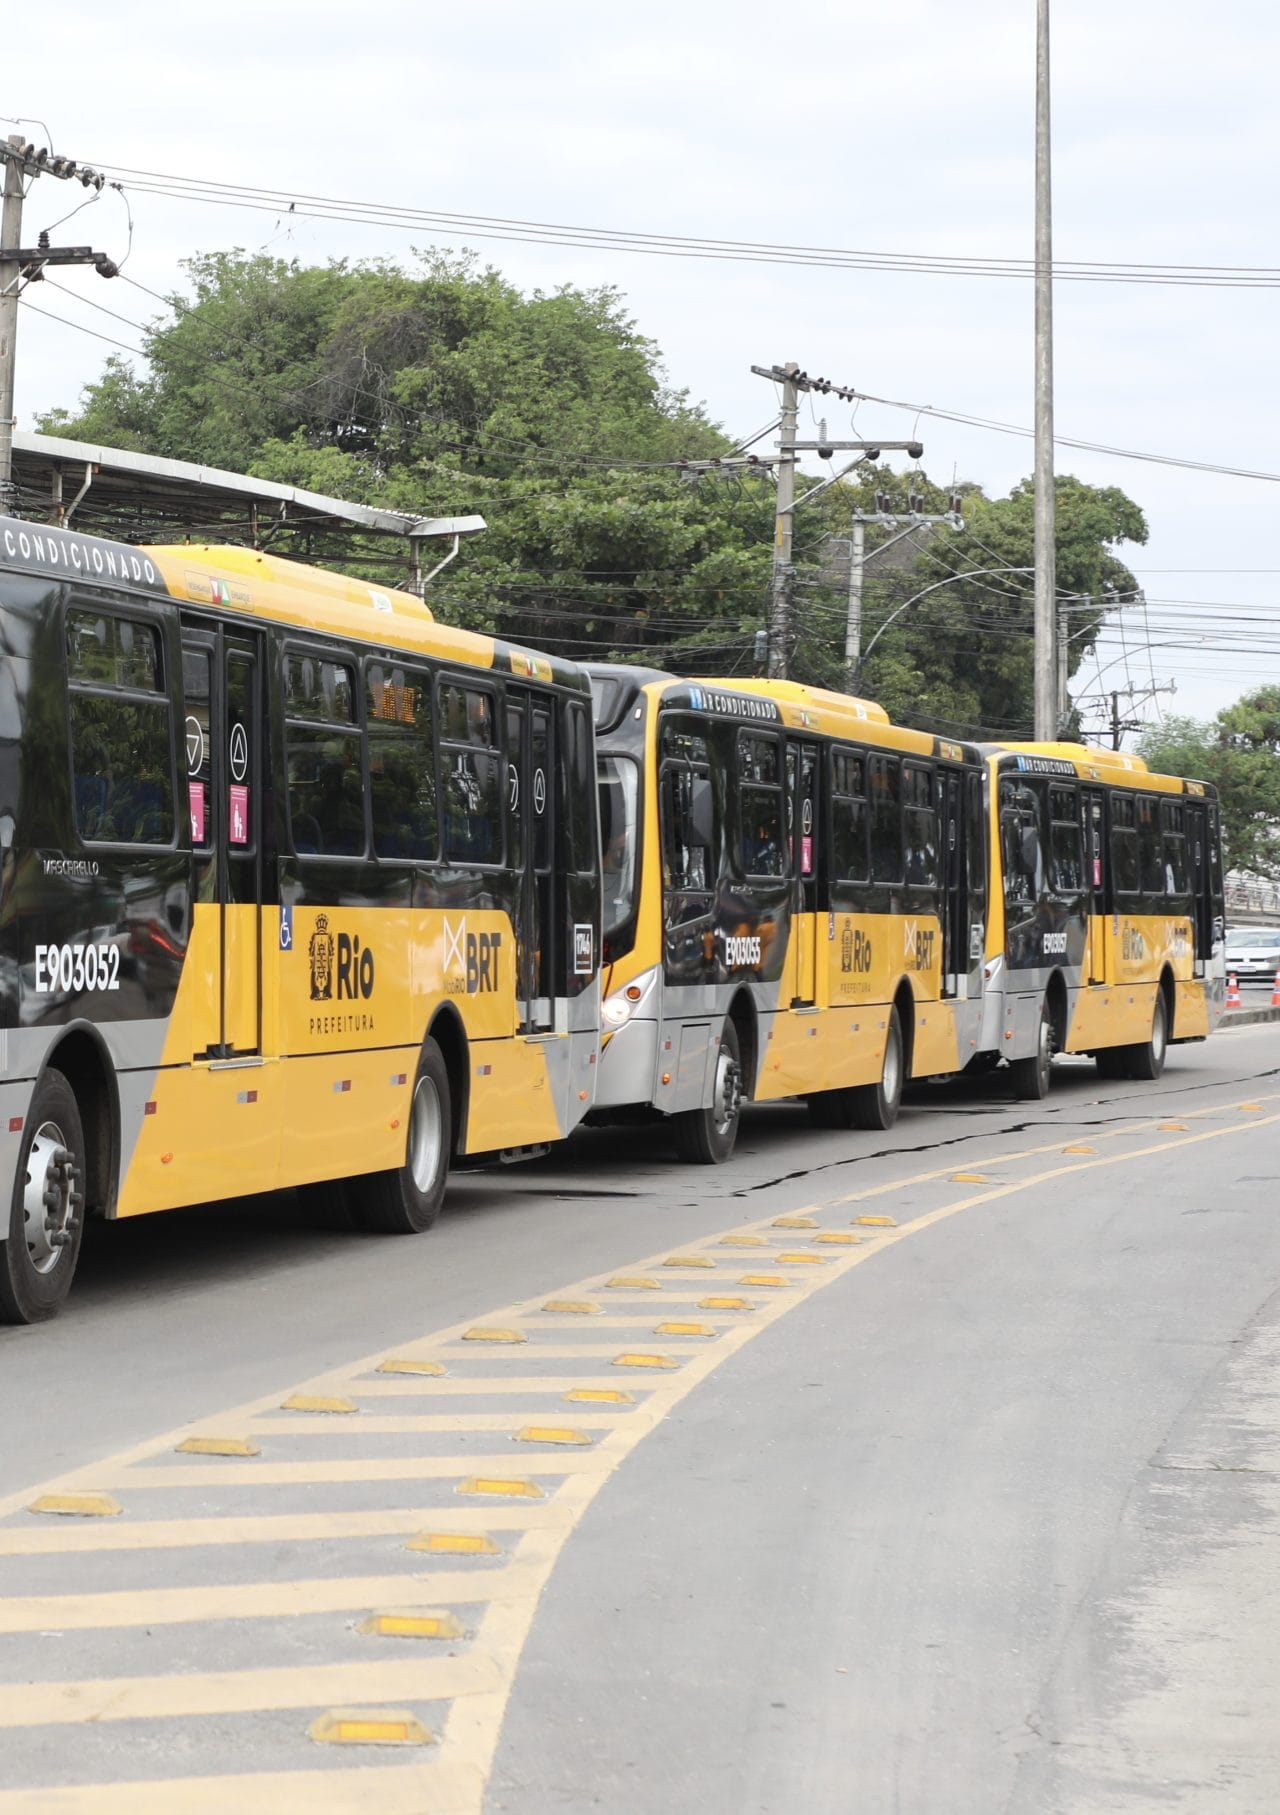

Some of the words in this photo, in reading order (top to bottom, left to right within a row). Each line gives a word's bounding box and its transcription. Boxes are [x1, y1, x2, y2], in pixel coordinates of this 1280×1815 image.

[4, 529, 155, 585] CONDICIONADO
[715, 696, 777, 719] CONDICIONADO
[34, 943, 120, 993] E903052
[336, 932, 375, 1000] Rio
[467, 932, 502, 994] BRT
[725, 936, 761, 966] E903055
[853, 929, 872, 973] Rio
[916, 930, 935, 971] BRT
[309, 1015, 375, 1035] PREFEITURA
